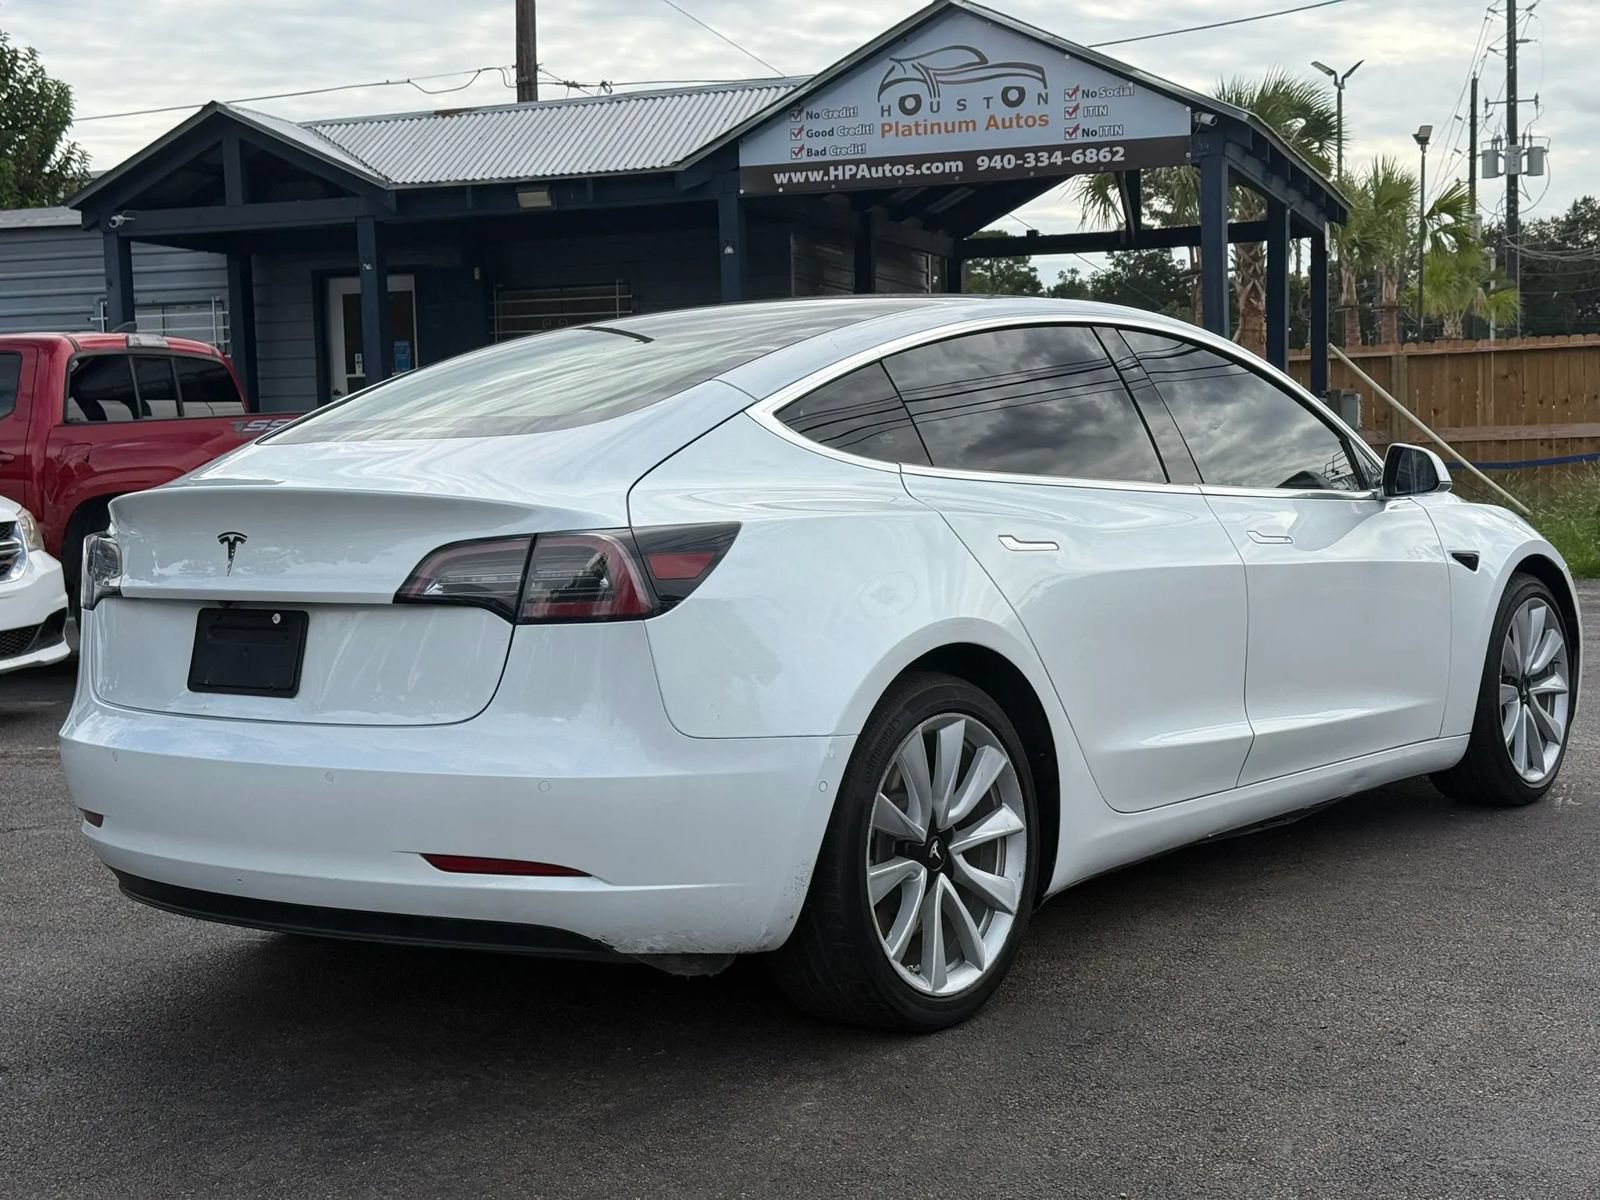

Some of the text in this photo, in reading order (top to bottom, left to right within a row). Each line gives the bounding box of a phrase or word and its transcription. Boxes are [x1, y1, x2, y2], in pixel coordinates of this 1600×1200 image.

[1081, 85, 1135, 99] No Social
[805, 106, 859, 120] No Credit!
[1082, 105, 1108, 118] ITIN
[806, 124, 874, 139] Good Credit!
[880, 112, 1049, 139] Platinum Autos
[1081, 124, 1124, 138] No ITIN
[806, 143, 866, 157] Bad Credit!
[774, 147, 1125, 184] www.HPAutos.com 940-334-6862
